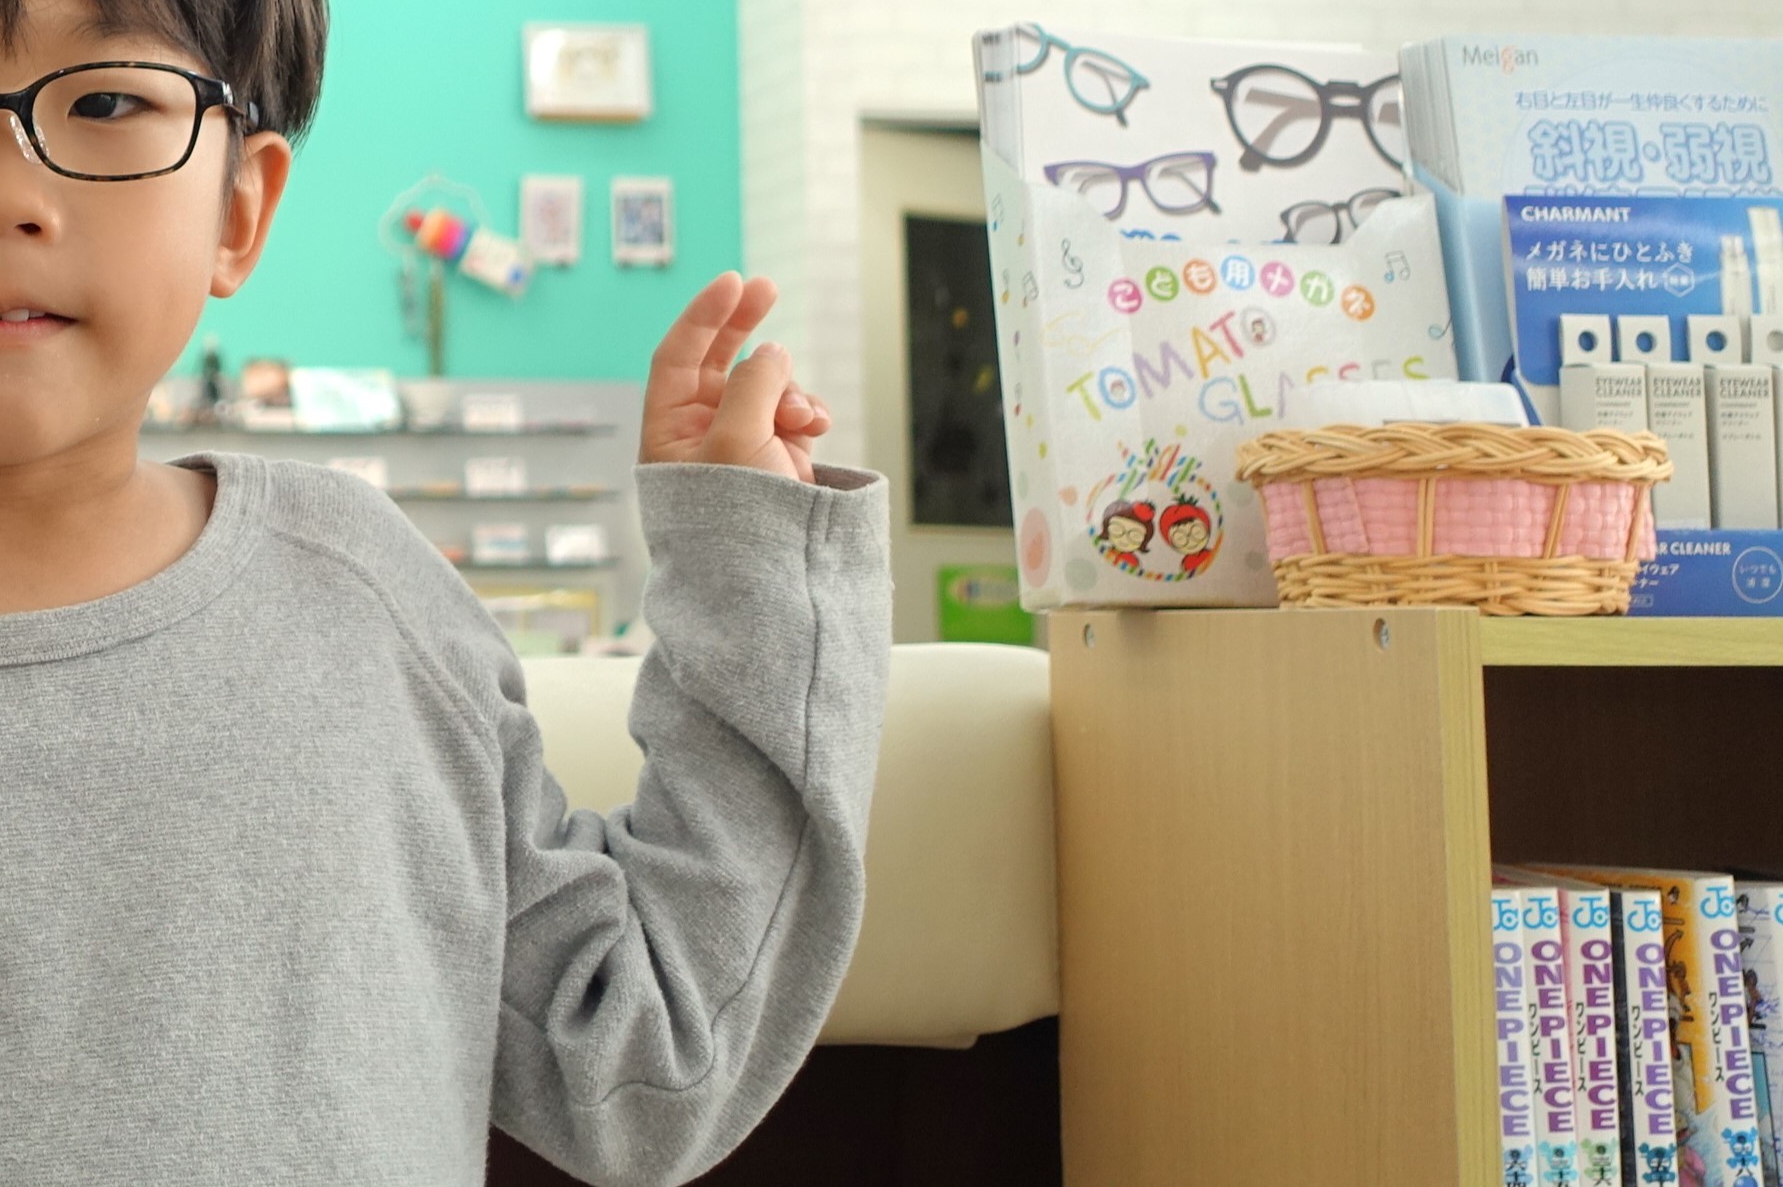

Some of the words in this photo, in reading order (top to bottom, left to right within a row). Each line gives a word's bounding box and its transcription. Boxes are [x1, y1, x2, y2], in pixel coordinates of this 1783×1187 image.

[1462, 45, 1539, 74] Meigan
[1521, 205, 1631, 223] CHARMANT
[1526, 240, 1694, 263] メガネにひとふき
[1527, 267, 1658, 292] 簡単お手入れ
[1110, 256, 1374, 320] こども用メガネ
[1067, 306, 1276, 422] TOMATO
[1670, 542, 1731, 555] CLEANER
[1494, 942, 1523, 1012] ONE
[1531, 940, 1563, 1010] ONE
[1580, 940, 1612, 1008] ONE
[1635, 943, 1666, 1012] ONE
[1710, 929, 1742, 998] ONE
[1528, 1003, 1543, 1095] ワンピース
[1575, 1001, 1587, 1092] ワンピース
[1631, 1005, 1644, 1097] ワンピース
[1708, 991, 1725, 1083] ワンピース
[1719, 1003, 1756, 1121] PIECE
[1497, 1018, 1530, 1137] PIECE
[1539, 1015, 1574, 1133] PIECE
[1585, 1014, 1616, 1132] PIECE
[1642, 1018, 1673, 1136] PIECE
